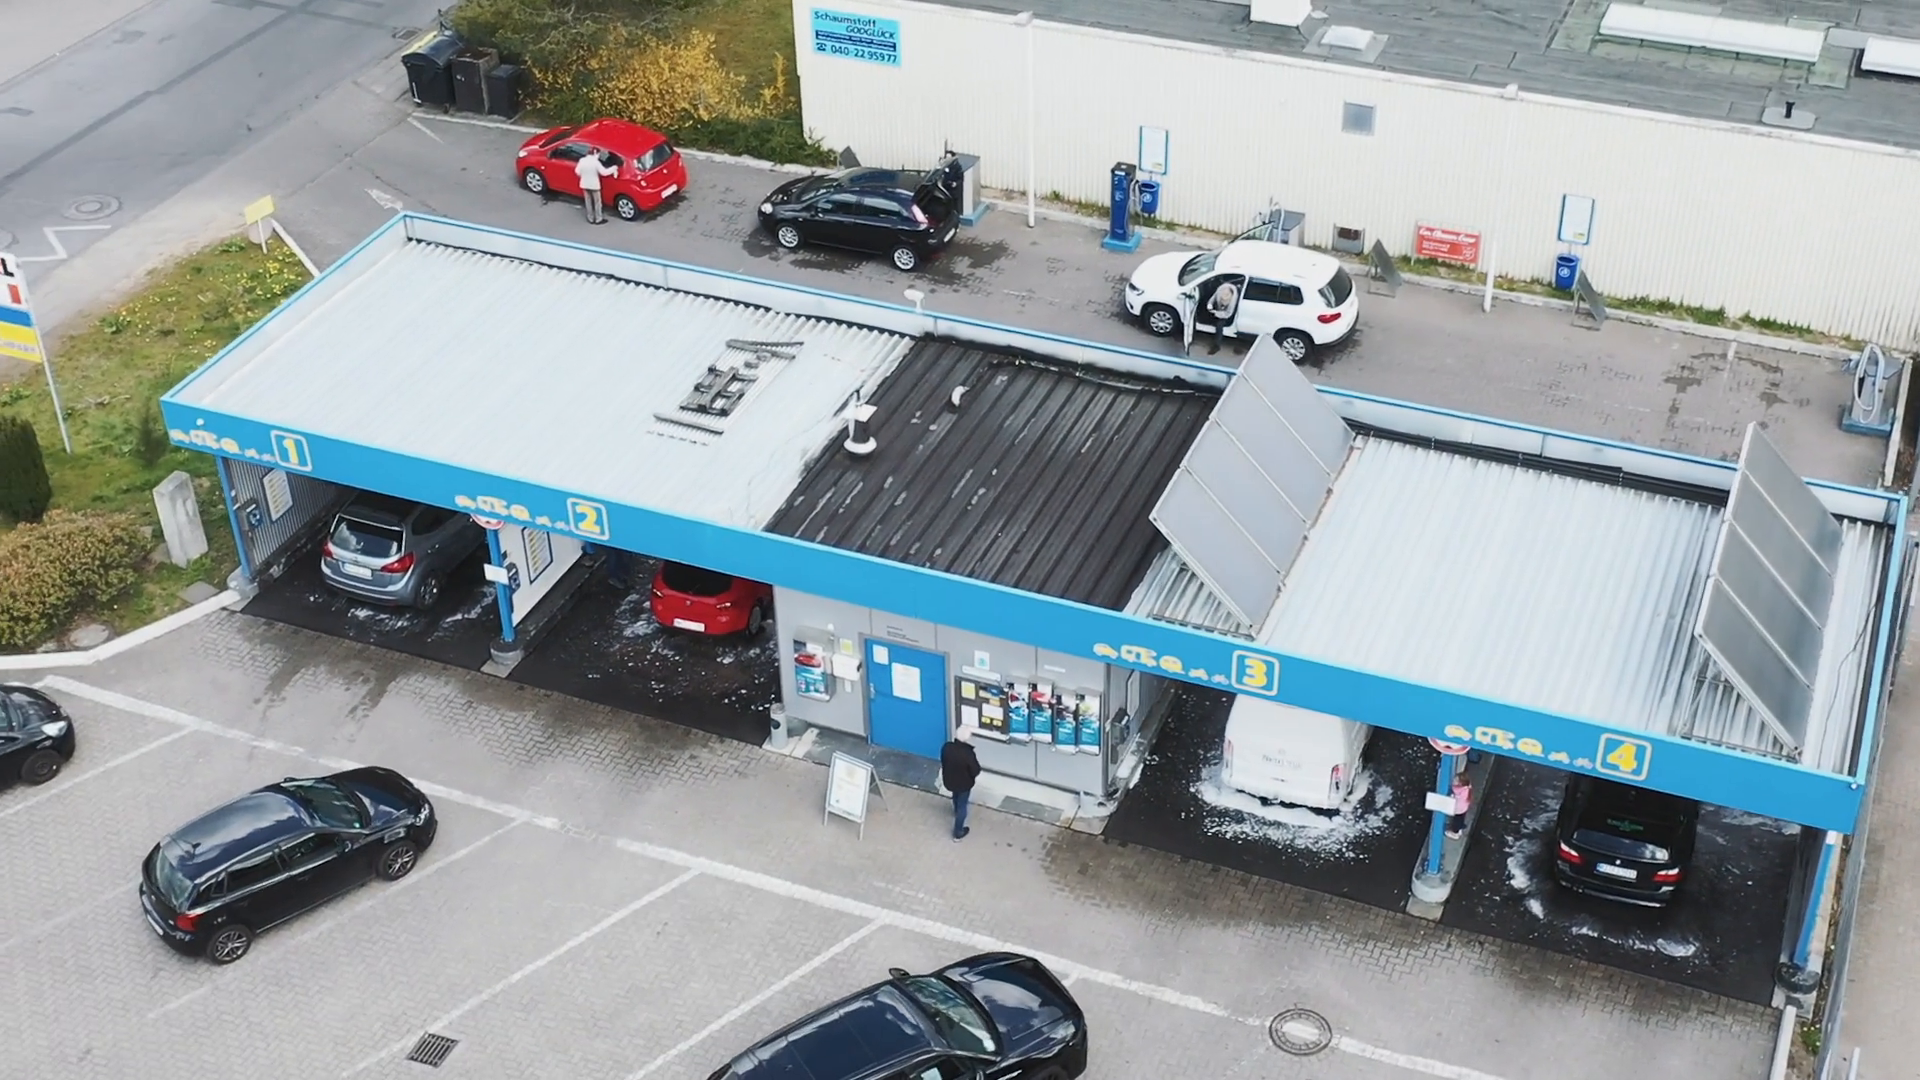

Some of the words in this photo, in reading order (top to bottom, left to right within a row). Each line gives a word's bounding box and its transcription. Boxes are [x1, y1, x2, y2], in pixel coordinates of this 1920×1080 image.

[814, 11, 877, 28] Schaumstoff
[282, 438, 300, 464] 1
[575, 505, 601, 531] 2
[1242, 658, 1267, 687] 3
[1606, 743, 1639, 772] 4
